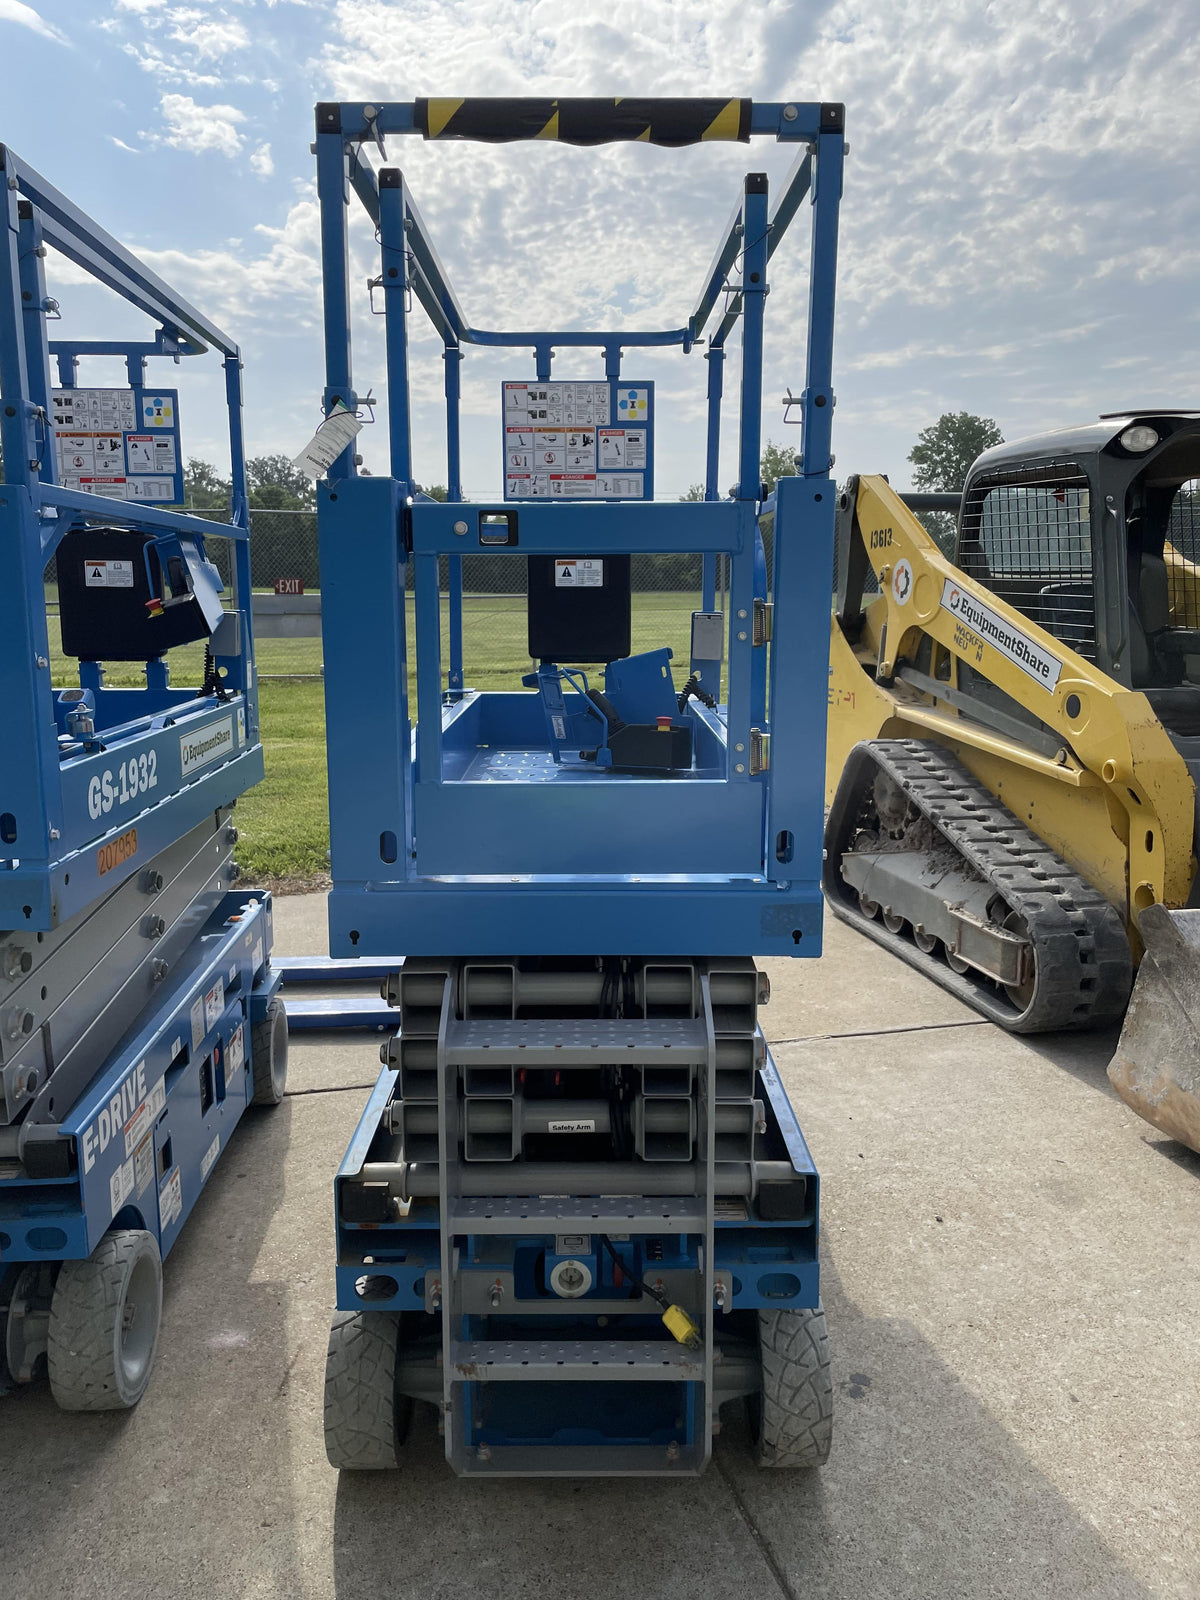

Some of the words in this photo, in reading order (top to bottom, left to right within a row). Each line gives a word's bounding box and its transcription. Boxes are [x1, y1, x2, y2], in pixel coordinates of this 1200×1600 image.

[871, 528, 893, 549] 13613
[279, 579, 300, 593] EXIT
[960, 597, 1050, 679] EquipmentShare
[188, 729, 231, 761] EquipmentShare
[88, 749, 158, 820] GS-1932
[98, 828, 138, 876] 207953
[82, 1059, 147, 1176] E-DRIVE
